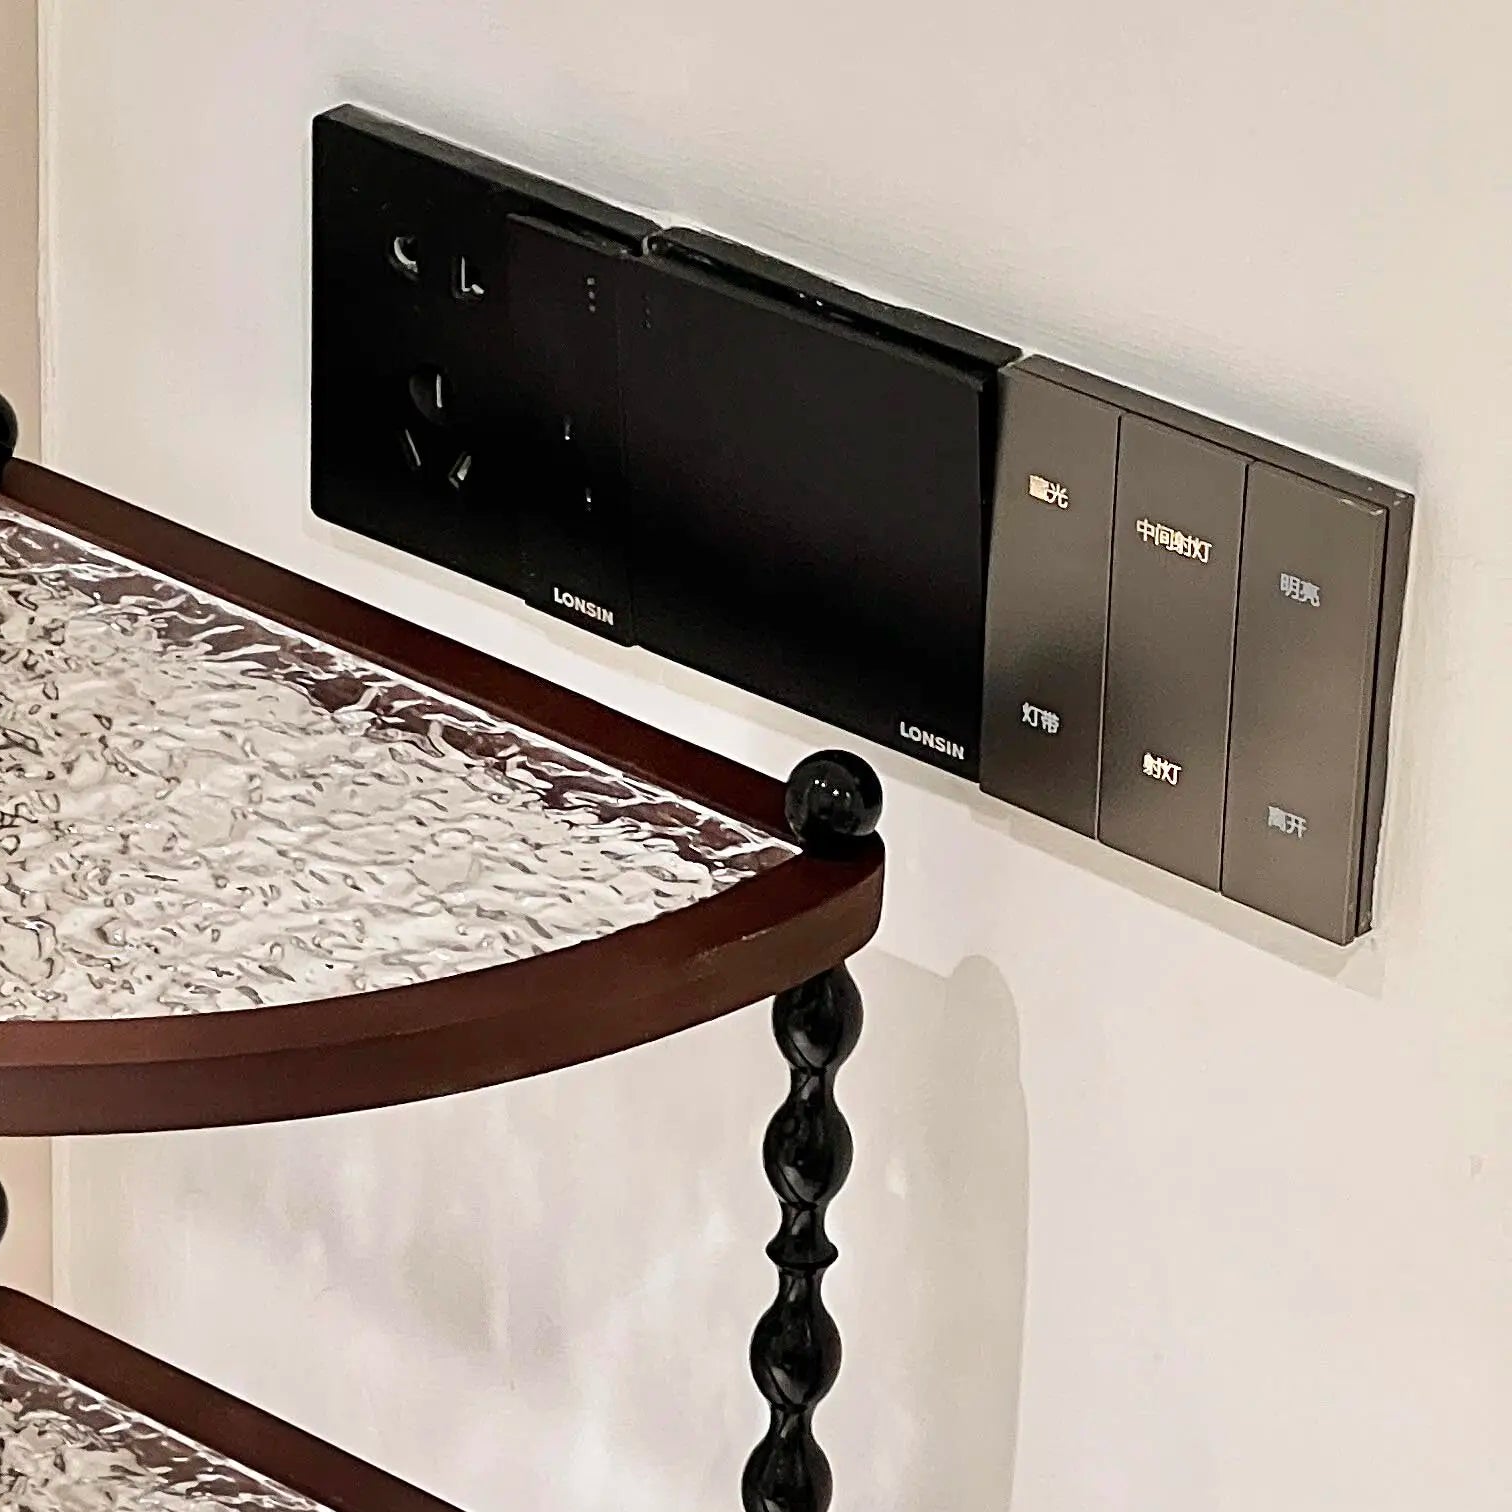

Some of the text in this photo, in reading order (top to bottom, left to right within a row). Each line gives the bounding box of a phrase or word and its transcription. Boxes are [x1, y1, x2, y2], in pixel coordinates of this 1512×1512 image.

[1137, 518, 1212, 563] 中间射灯
[553, 587, 614, 626] LONSIN
[1022, 702, 1060, 734] 灯带
[899, 721, 965, 760] LONSIN
